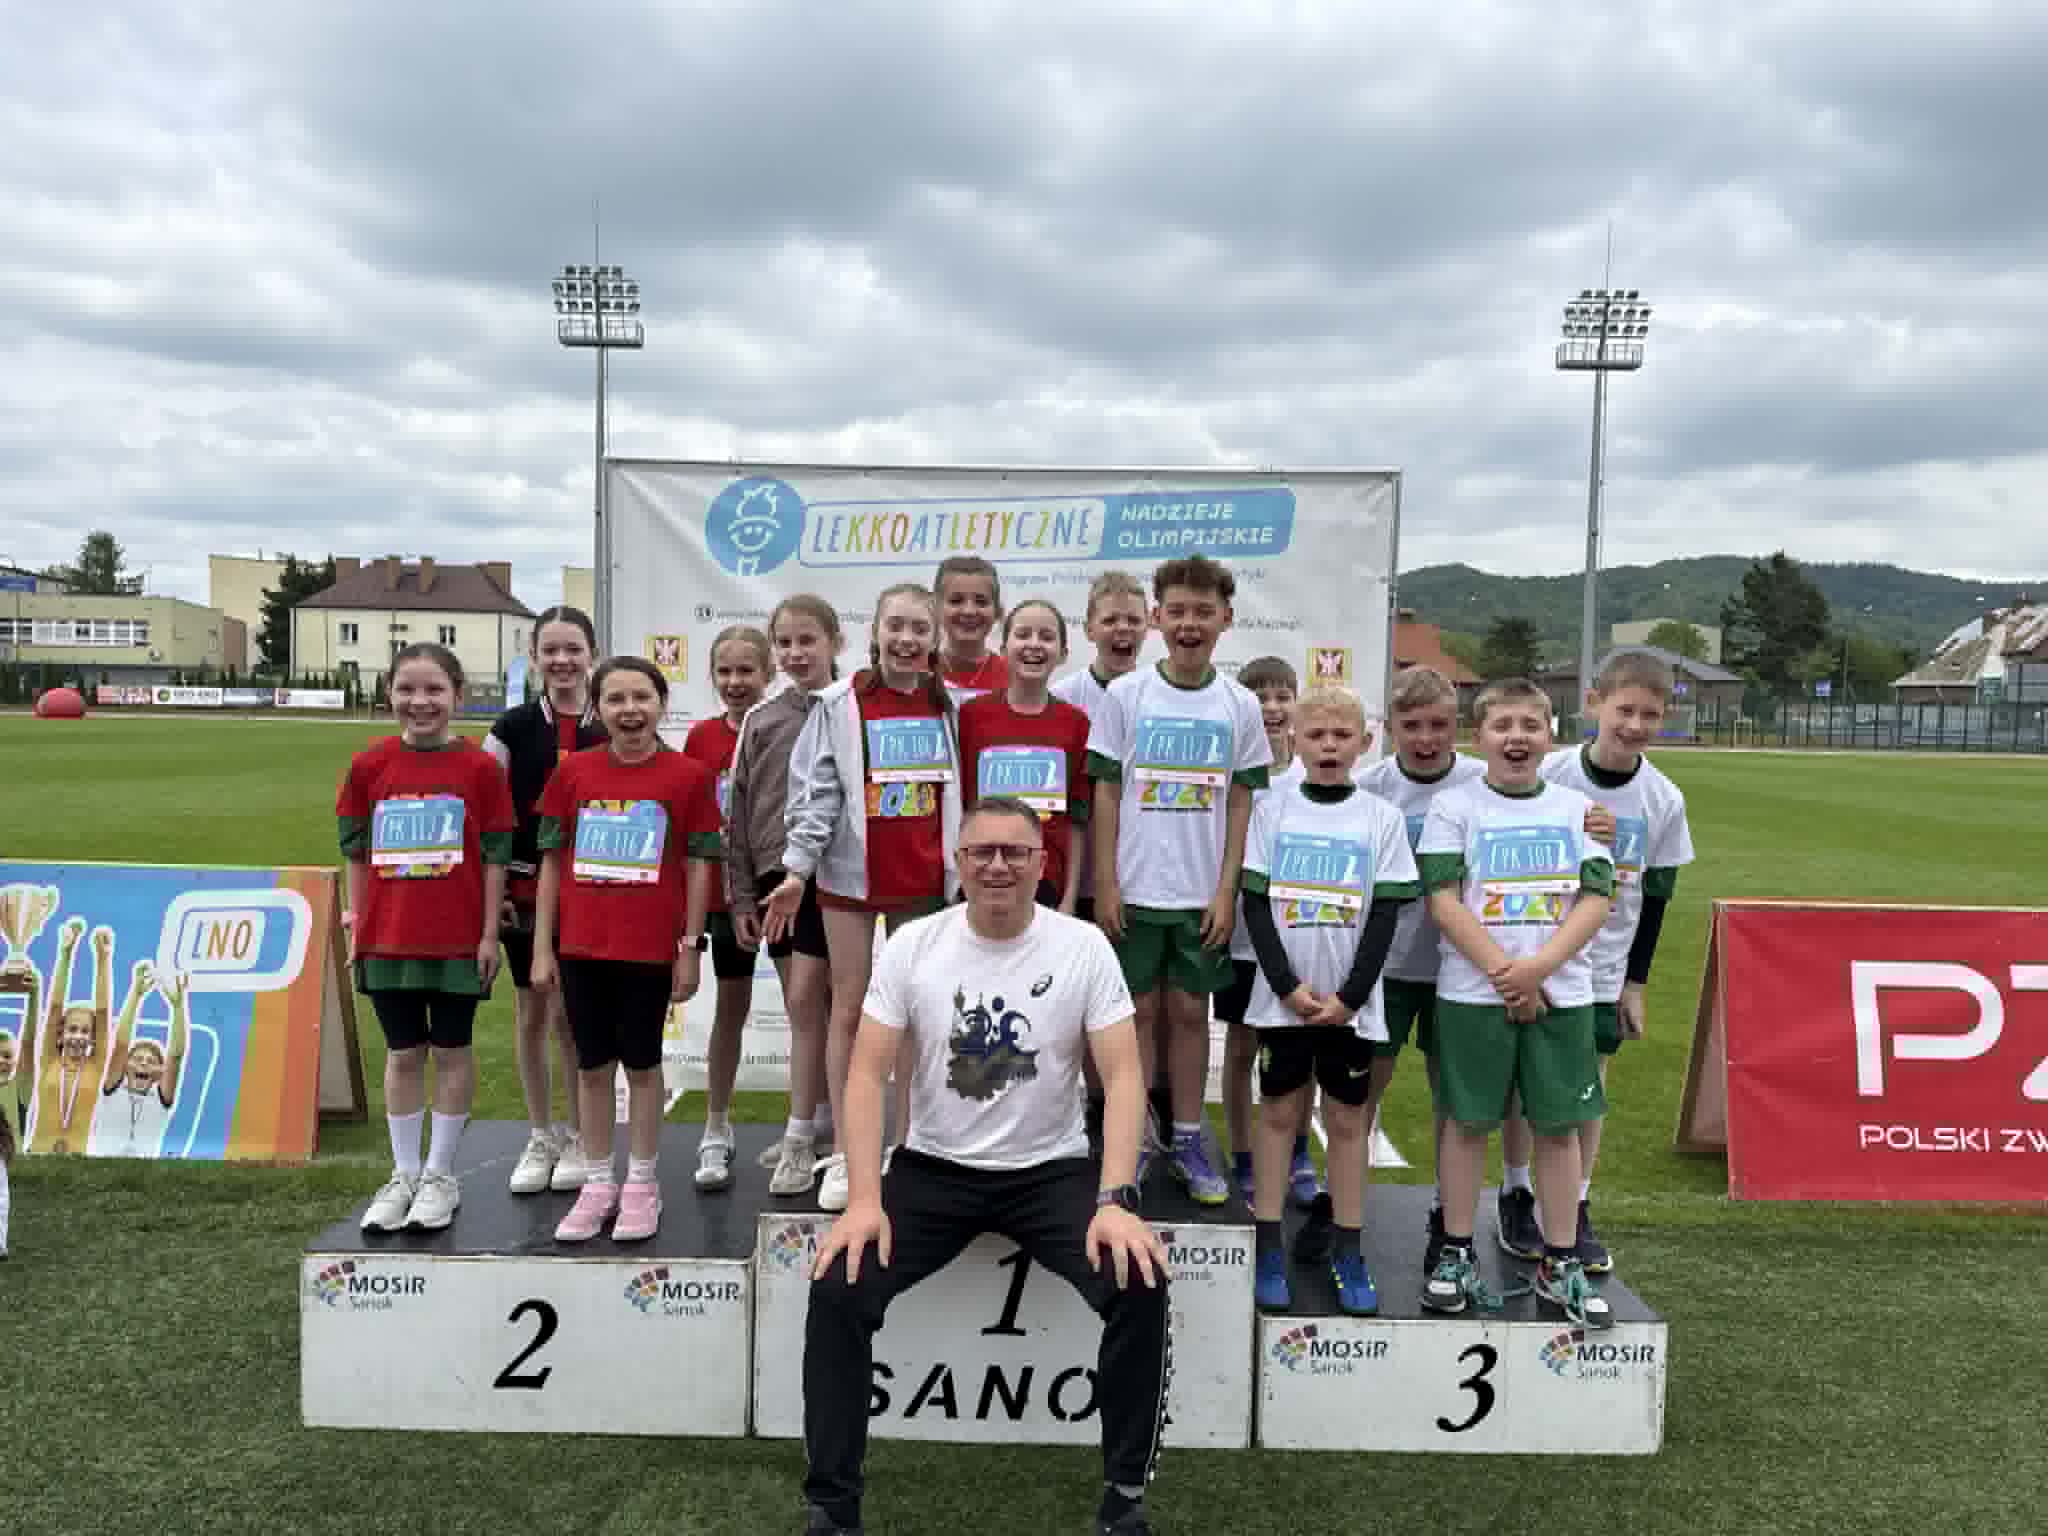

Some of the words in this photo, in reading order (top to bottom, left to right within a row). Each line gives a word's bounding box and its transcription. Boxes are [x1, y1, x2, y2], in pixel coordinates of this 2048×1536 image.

[812, 508, 1093, 553] LEKKOATLETYCZNE
[1120, 503, 1234, 521] NADZIEJE
[1118, 528, 1274, 549] OLIMPIJSKIE
[191, 919, 252, 959] LNO
[1860, 1124, 1991, 1152] POLSKI
[981, 1248, 1035, 1336] 1
[493, 1299, 557, 1388] 2
[870, 1361, 1174, 1424] SANO
[1436, 1343, 1498, 1432] 3
